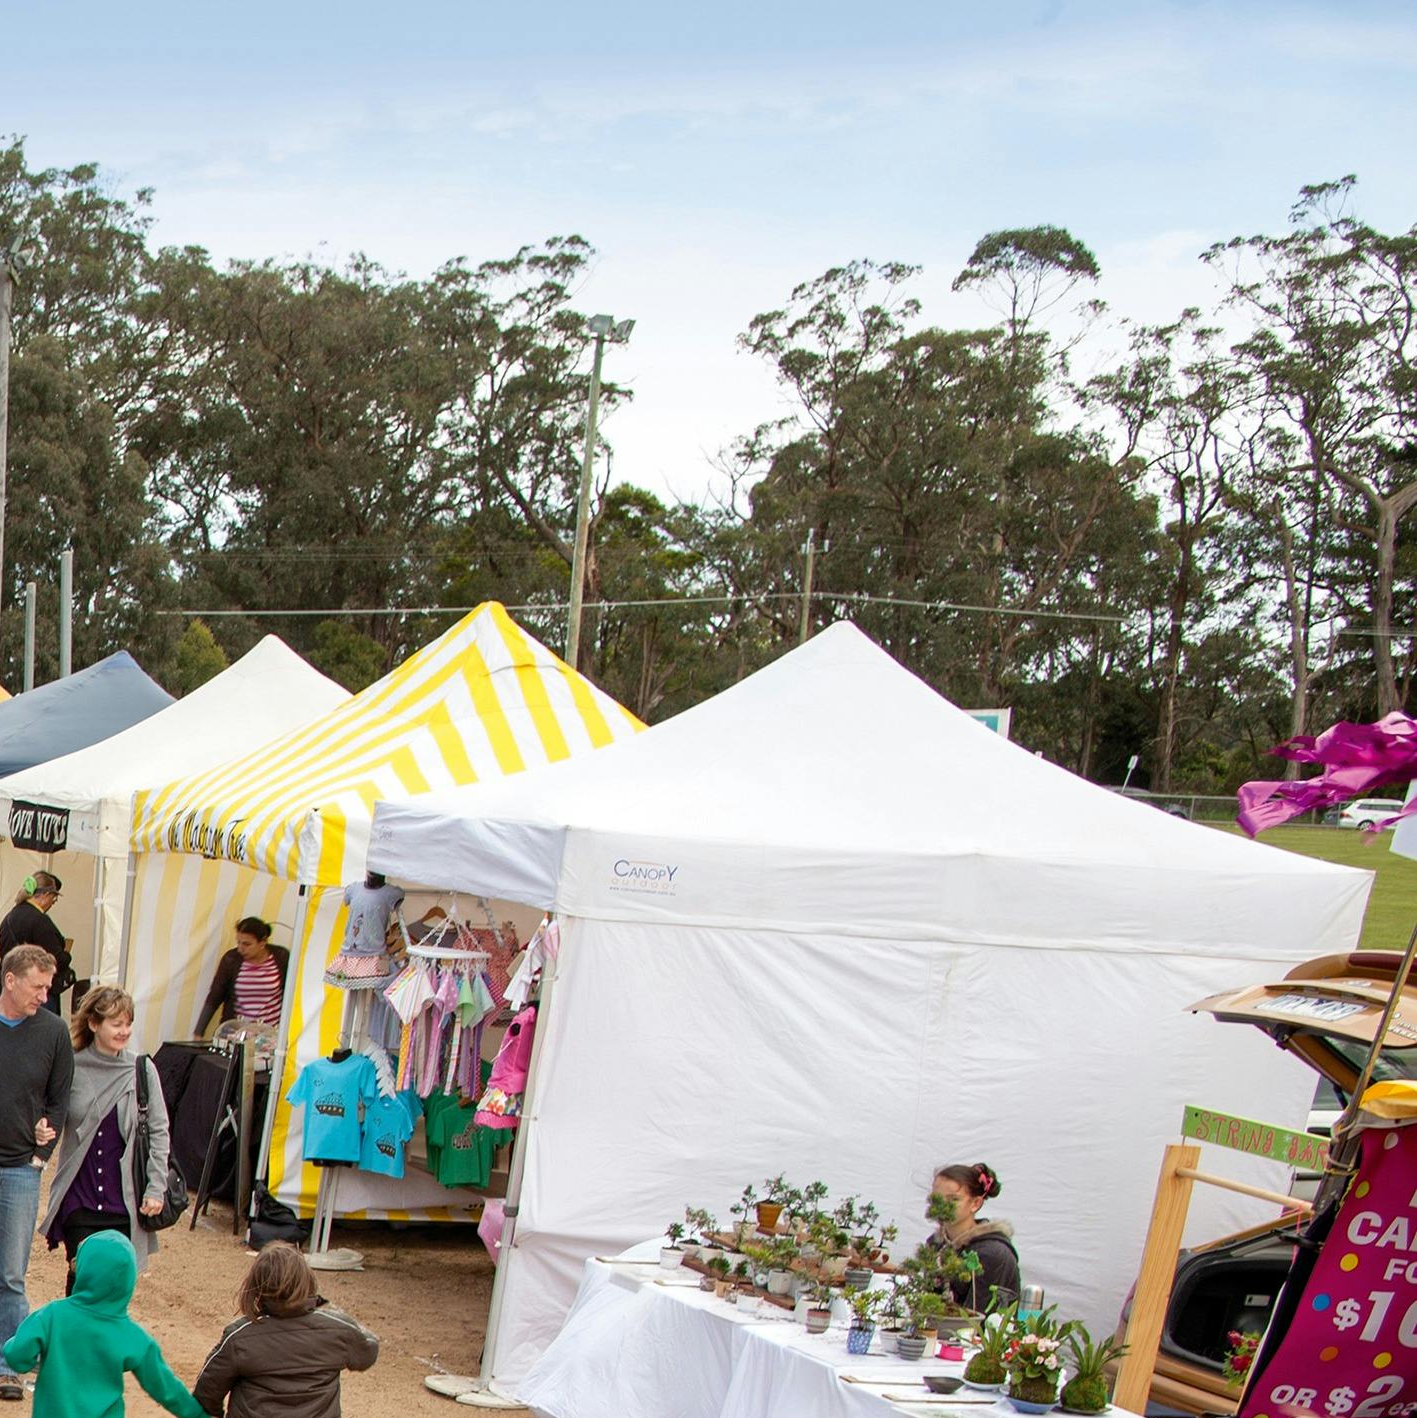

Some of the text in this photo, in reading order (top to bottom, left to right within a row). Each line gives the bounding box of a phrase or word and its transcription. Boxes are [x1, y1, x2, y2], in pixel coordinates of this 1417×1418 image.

[36, 811, 68, 845] NUTS
[1347, 1211, 1417, 1252] CA
[1270, 1384, 1317, 1409] OR
